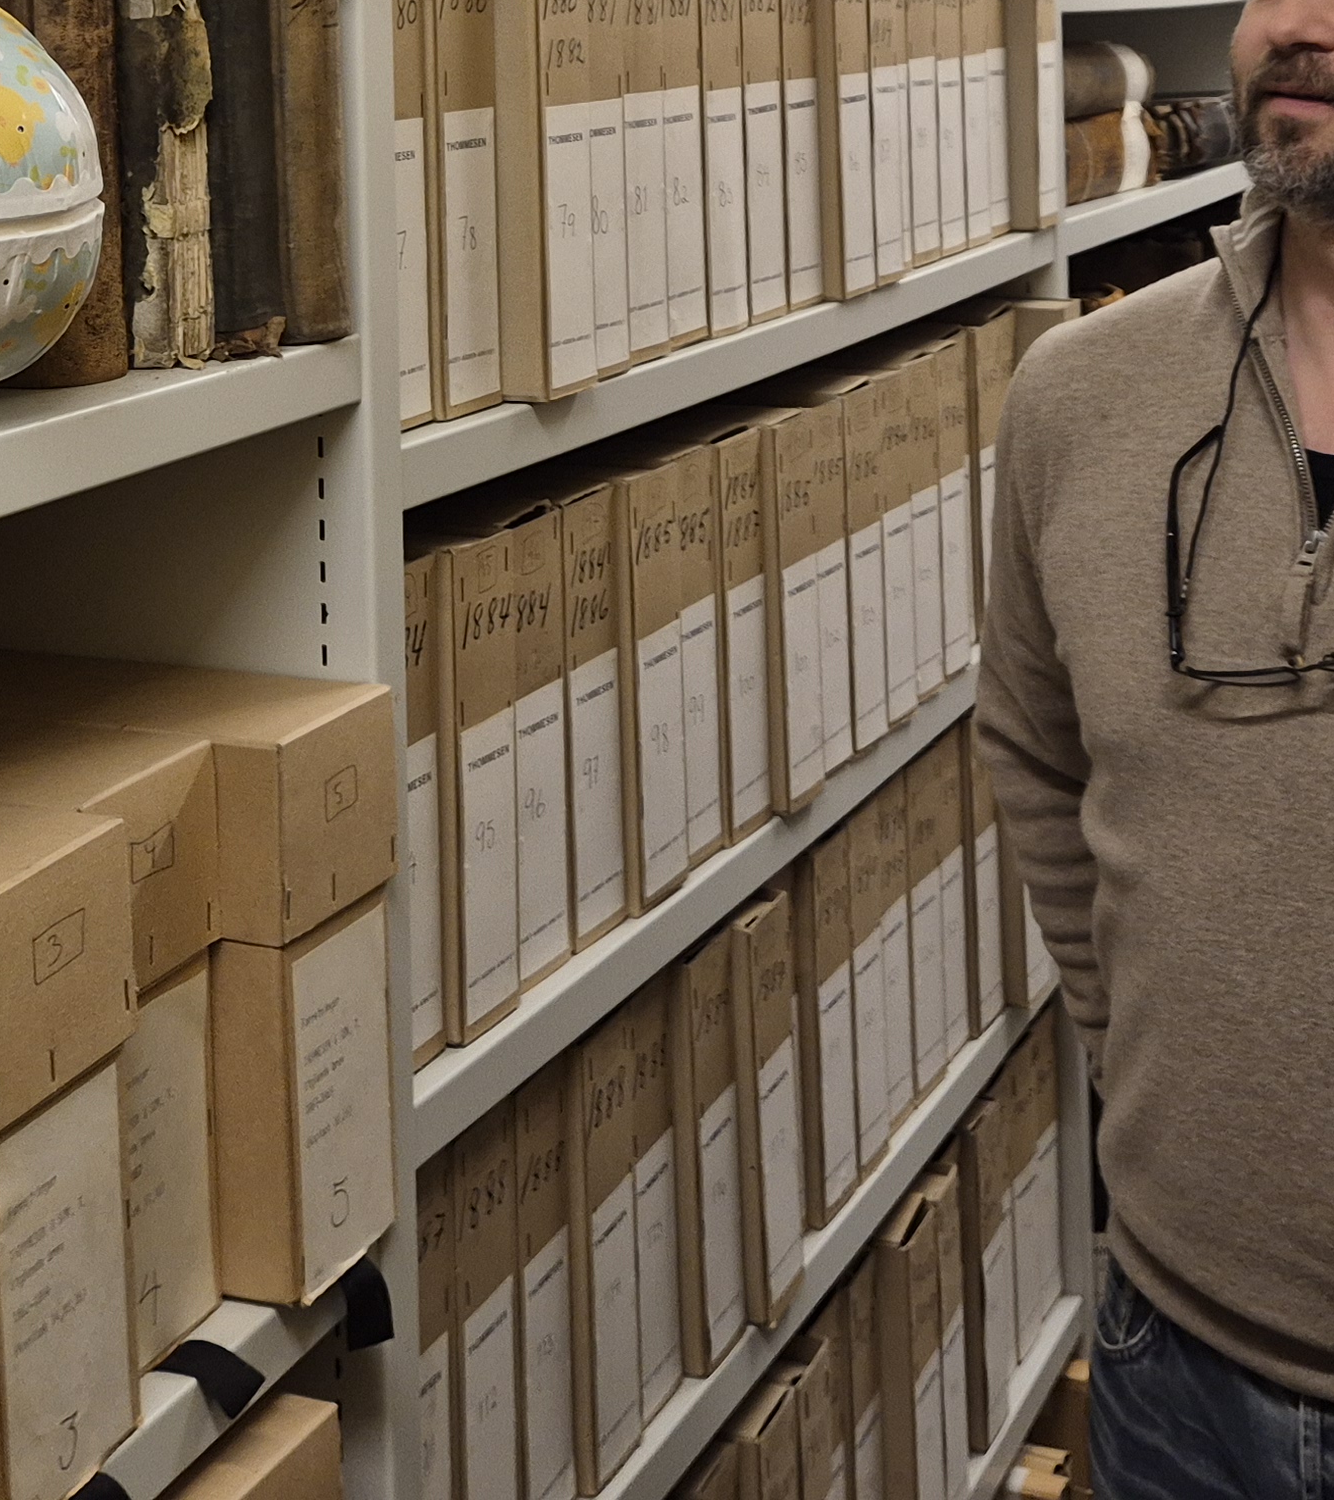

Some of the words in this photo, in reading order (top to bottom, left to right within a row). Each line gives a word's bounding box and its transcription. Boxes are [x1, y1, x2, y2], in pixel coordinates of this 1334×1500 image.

[547, 37, 586, 71] 1882
[446, 137, 487, 152] THOMMESEN
[548, 132, 584, 146] THOMMESEN
[634, 185, 648, 215] 81
[458, 215, 478, 251] 78
[557, 203, 576, 239] 79
[570, 546, 606, 588] 1884
[462, 592, 512, 650] 1884
[570, 588, 610, 638] 1886
[517, 711, 559, 740] THOMMESEN
[467, 744, 510, 773] THOMMESEN
[524, 786, 547, 821] 96
[474, 818, 496, 852] 95
[143, 841, 157, 869] 4
[46, 932, 64, 968] 3
[330, 1175, 351, 1228] 5
[138, 1268, 162, 1326] 4
[58, 1409, 79, 1471] 3
